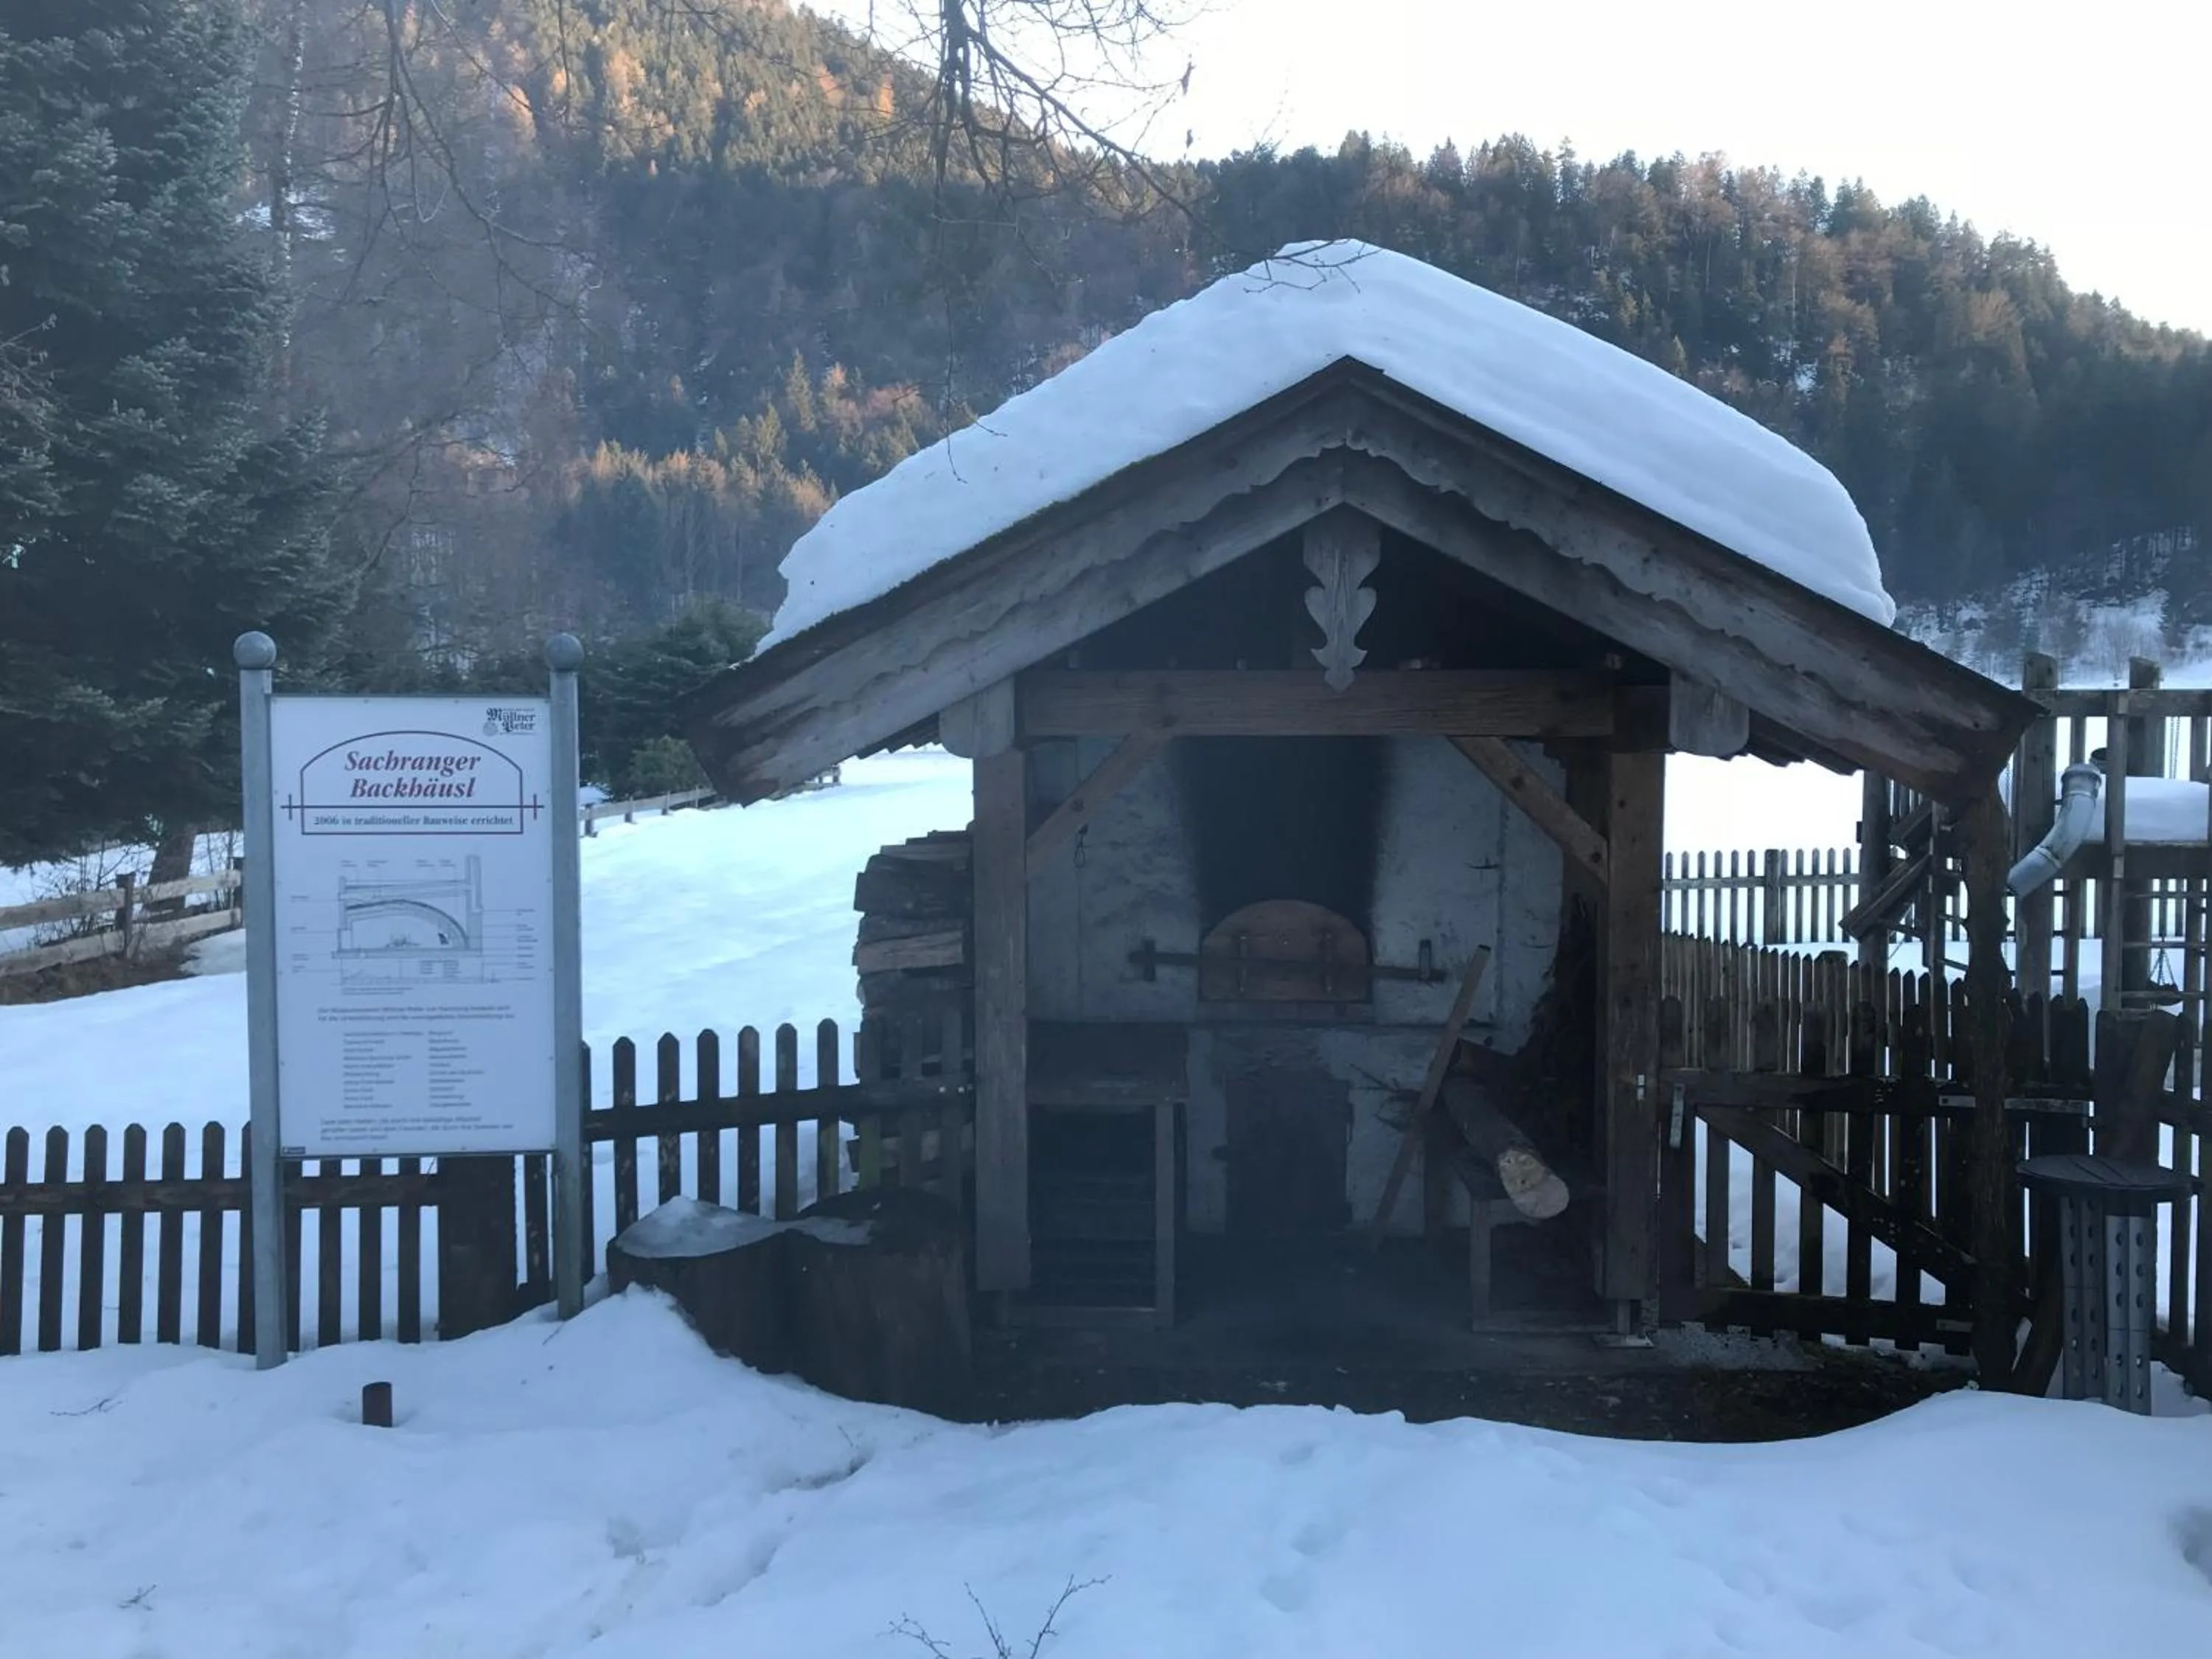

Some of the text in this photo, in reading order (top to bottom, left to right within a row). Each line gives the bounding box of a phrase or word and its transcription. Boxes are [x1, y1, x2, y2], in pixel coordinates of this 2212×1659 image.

[344, 750, 481, 776] Sachranger
[350, 777, 476, 798] Backhäusl
[313, 814, 514, 825] 2006 in traditioneller Bauweise errichtet
